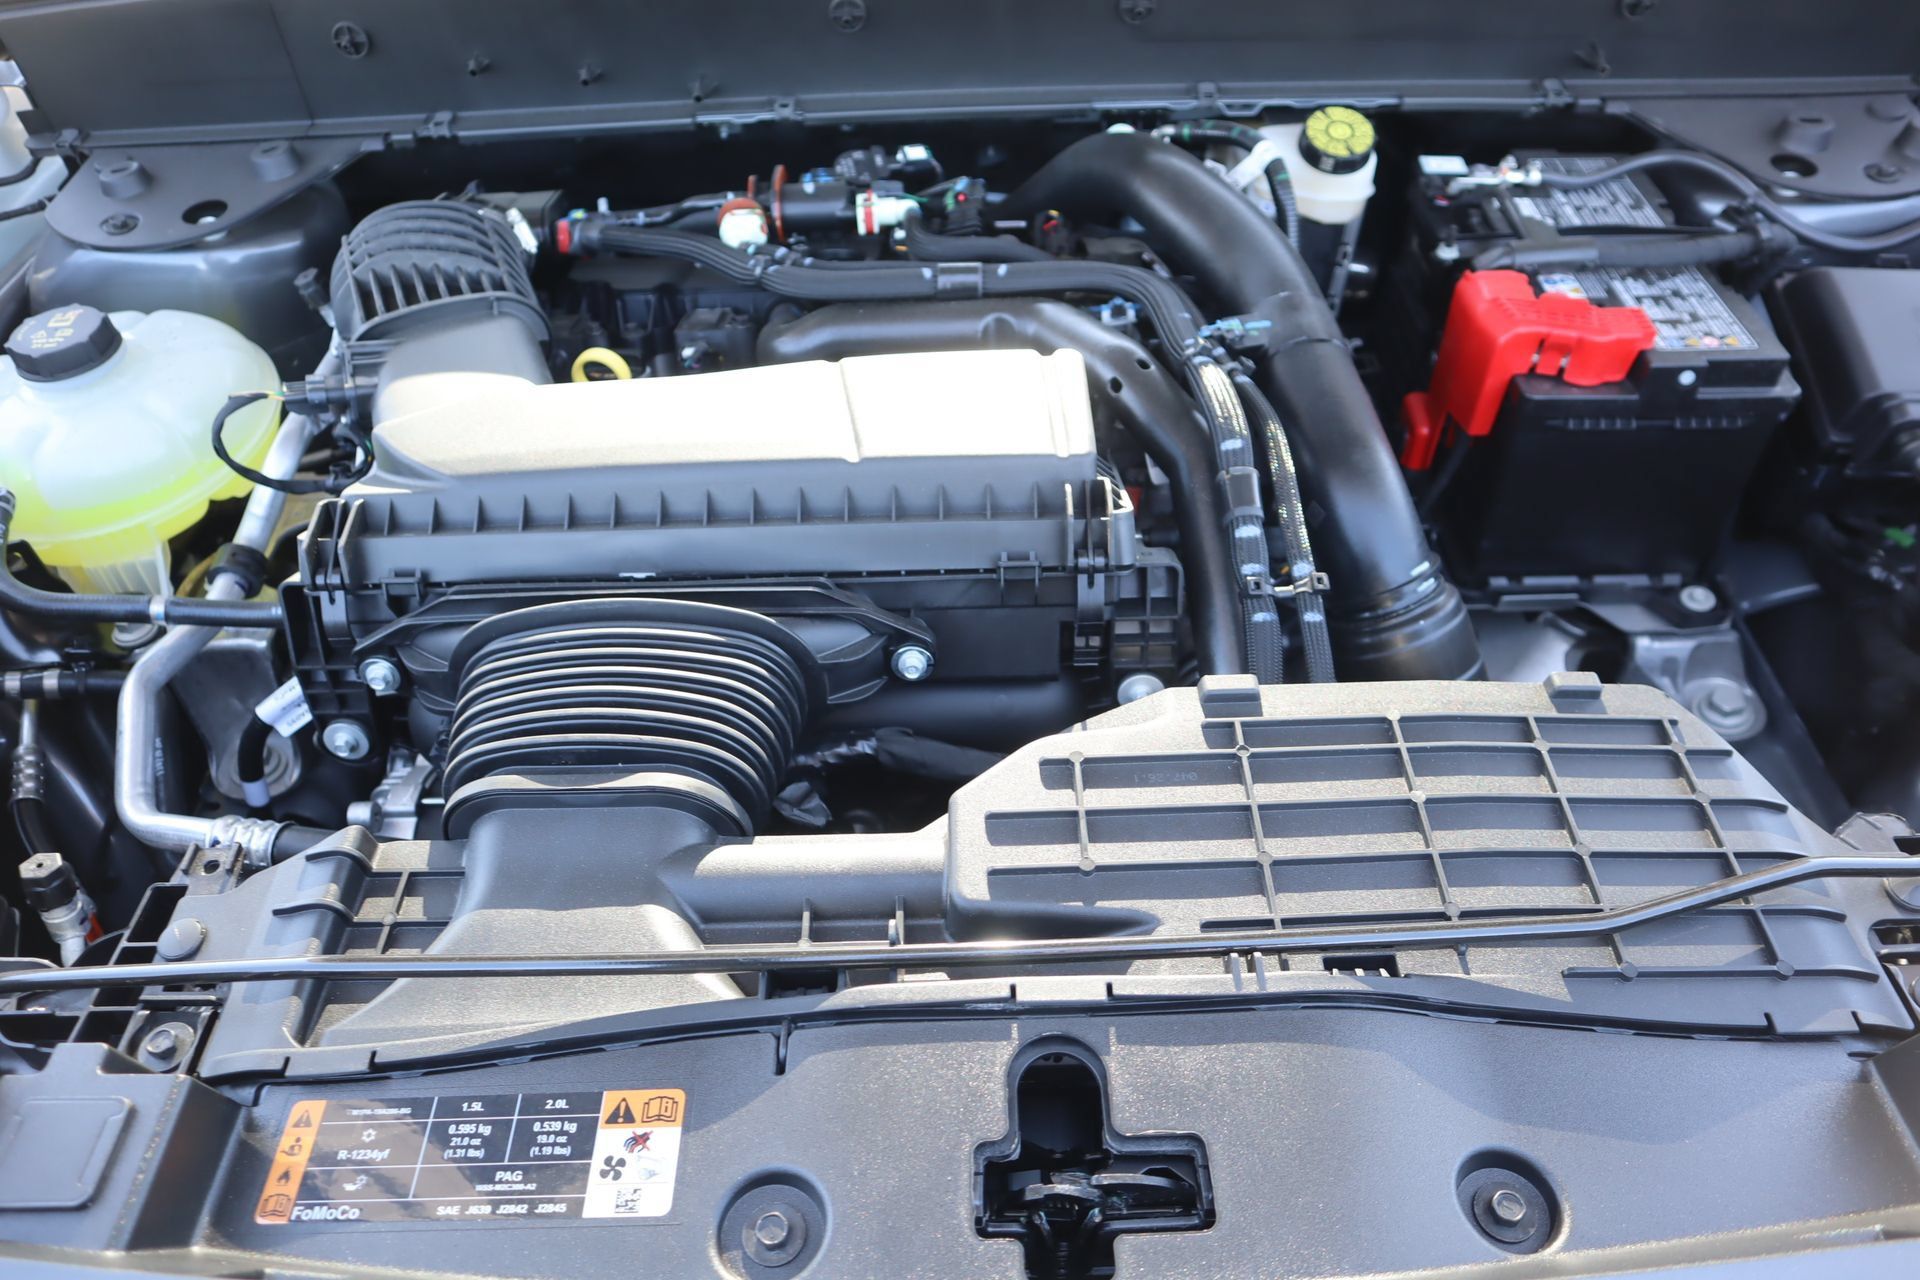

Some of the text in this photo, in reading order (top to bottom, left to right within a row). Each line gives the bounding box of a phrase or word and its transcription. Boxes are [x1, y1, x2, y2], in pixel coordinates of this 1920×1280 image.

[462, 1102, 485, 1112] 1.5L
[545, 1099, 570, 1109] 2.0L
[448, 1123, 492, 1136] 0.595 kg
[533, 1121, 577, 1133] 0.539 kg
[450, 1137, 471, 1146] 21.0
[536, 1135, 555, 1143] 19.0
[337, 1149, 391, 1162] R-1234yf
[444, 1148, 485, 1160] (1.31 lbs)
[530, 1145, 572, 1158] (1.19 lbs)
[495, 1171, 523, 1182] PAG
[290, 1206, 361, 1220] FoMoCo
[436, 1203, 567, 1216] SAE J639 J2842 J2845
